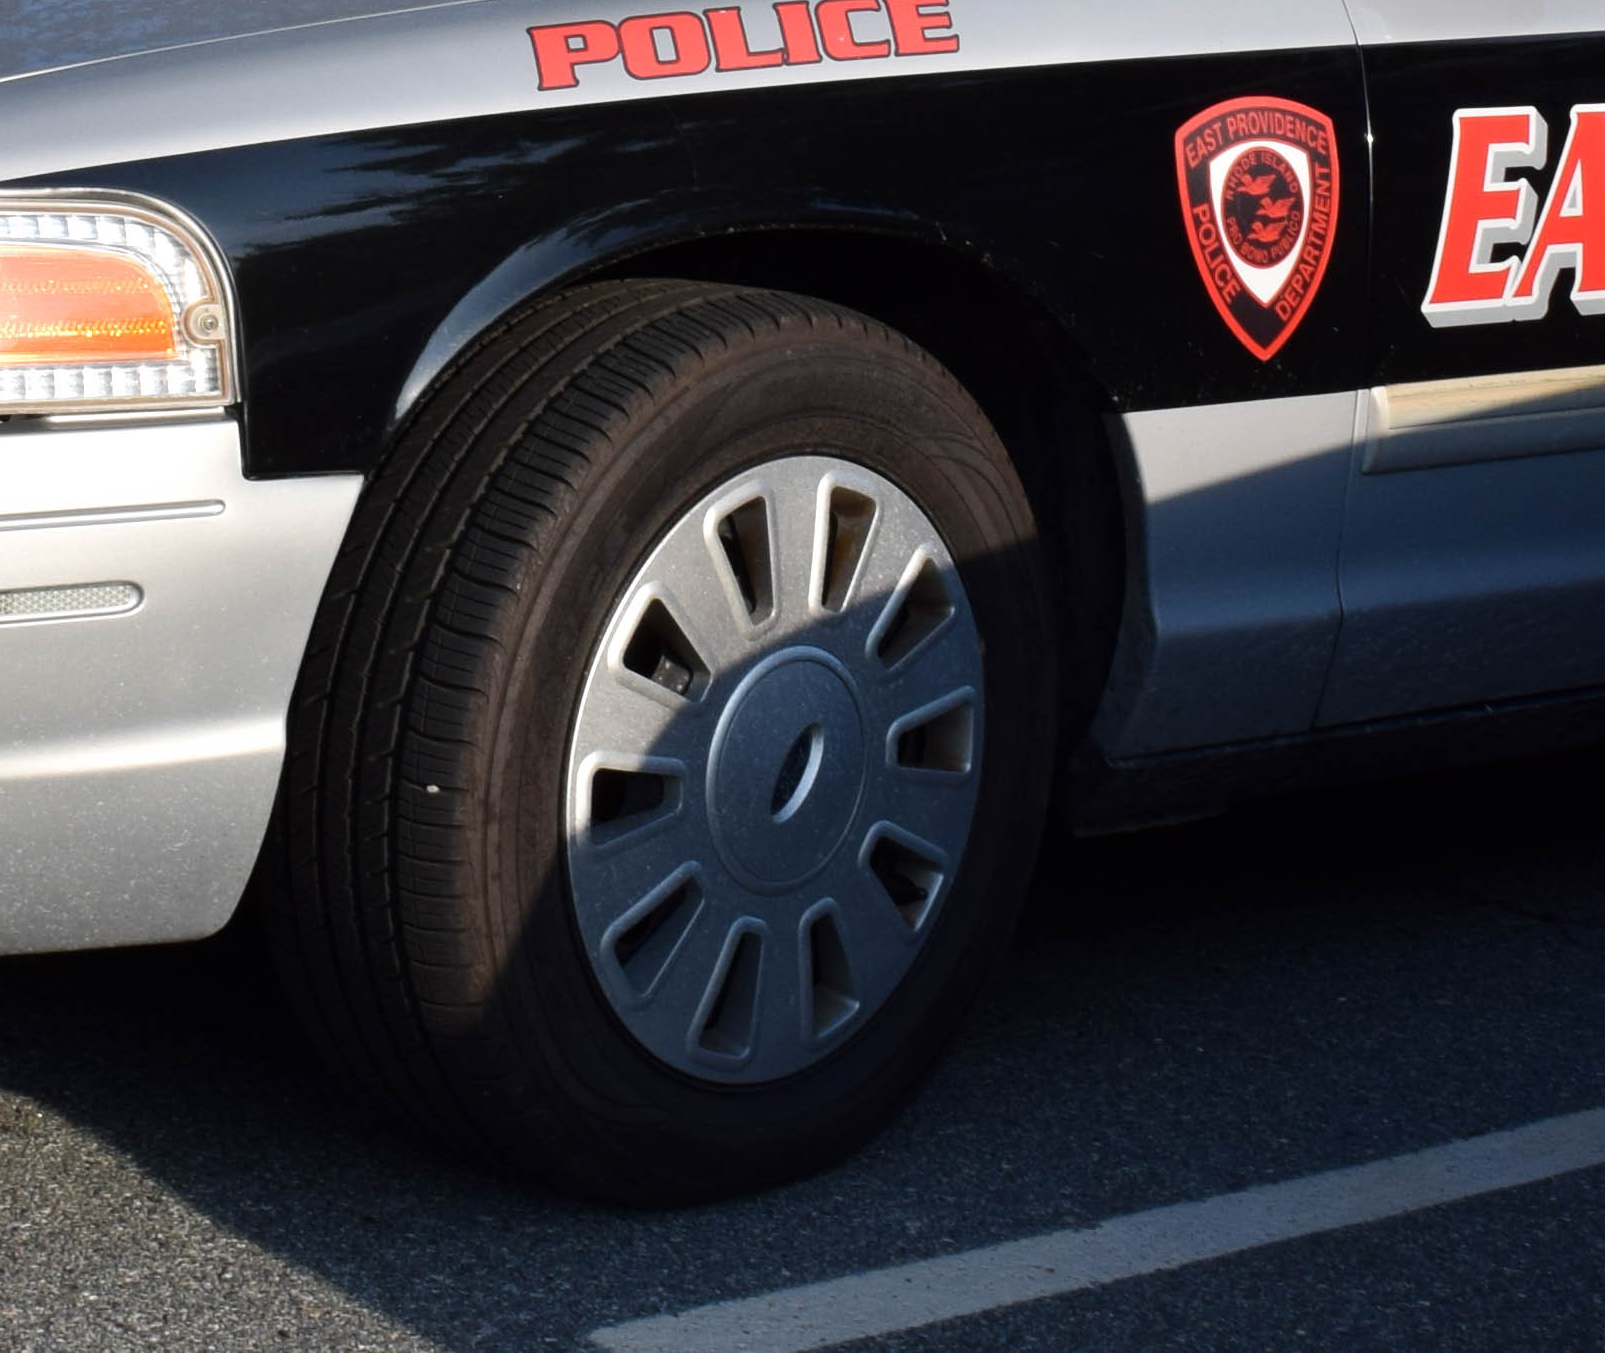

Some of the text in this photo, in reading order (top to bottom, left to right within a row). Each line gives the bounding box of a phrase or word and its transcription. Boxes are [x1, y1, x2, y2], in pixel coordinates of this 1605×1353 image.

[1186, 110, 1328, 169] EAST PROVIDENCE
[1225, 152, 1298, 200] RHODE ISLAND
[1193, 203, 1241, 305] POLICE
[1275, 162, 1331, 322] DEPARTMENT
